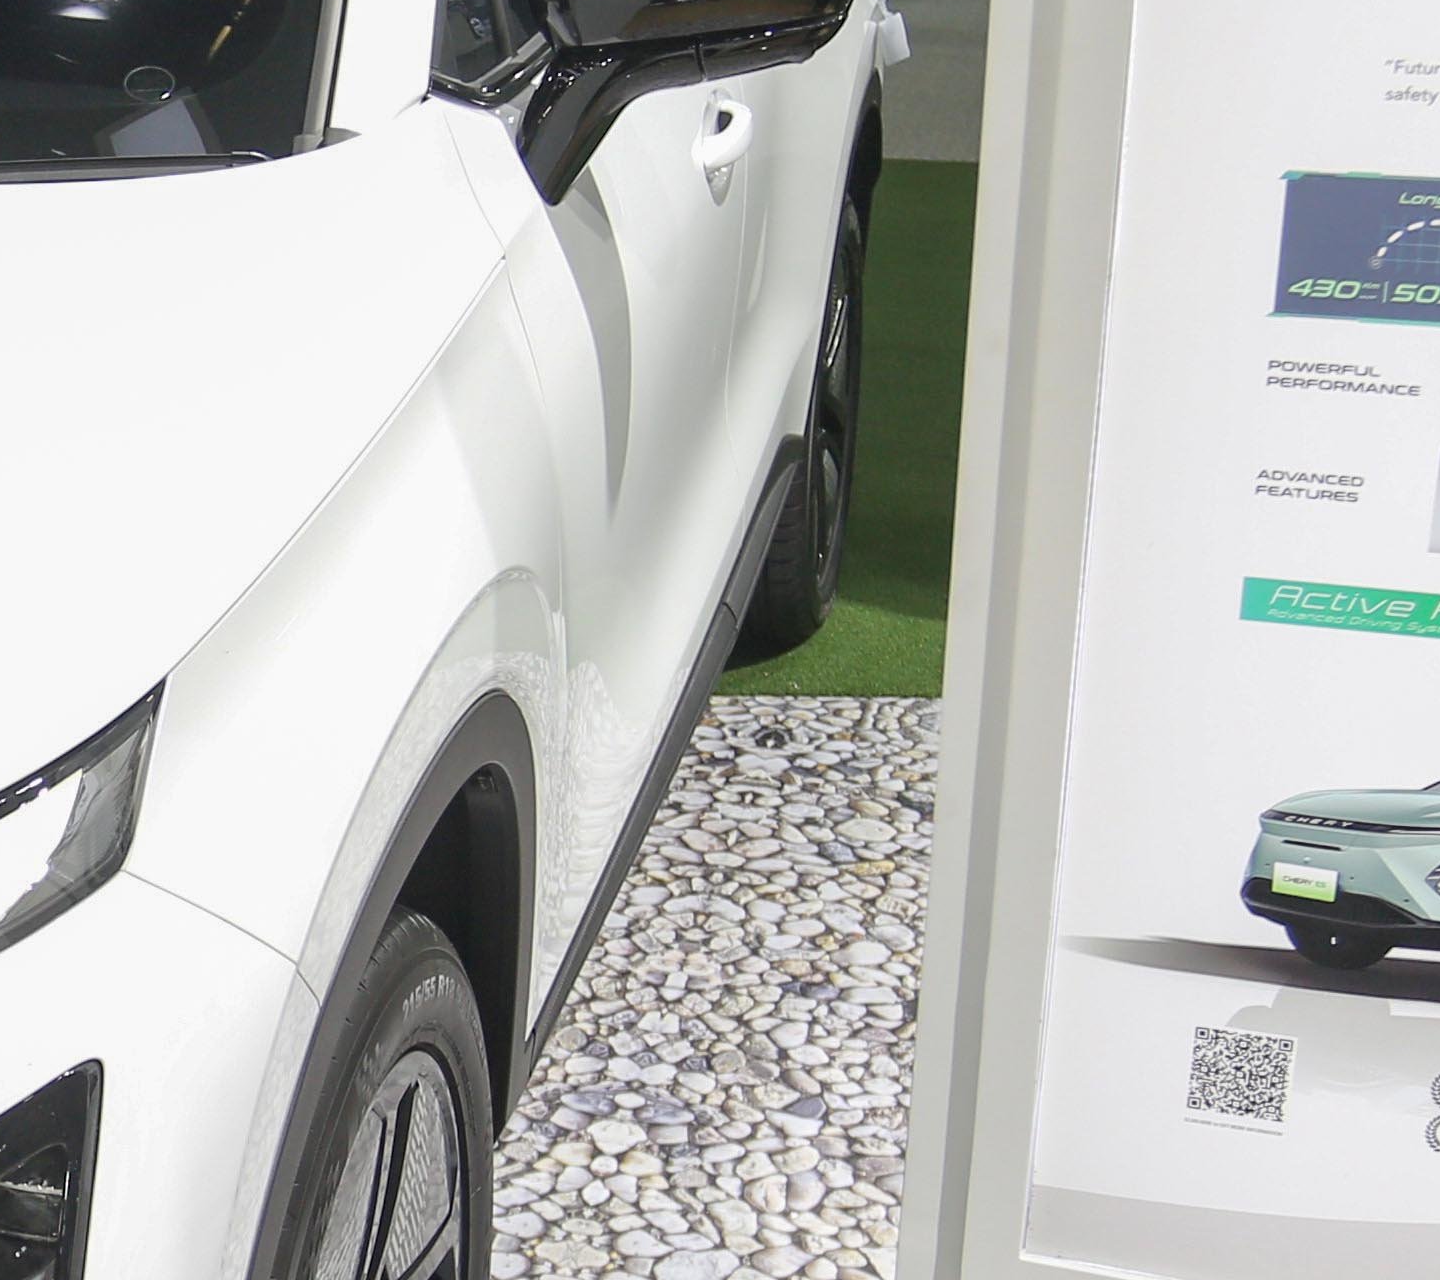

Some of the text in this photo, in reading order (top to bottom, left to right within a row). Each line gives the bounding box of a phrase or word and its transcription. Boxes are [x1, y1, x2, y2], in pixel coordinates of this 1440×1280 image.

[1385, 87, 1439, 105] safety
[1288, 278, 1361, 300] 430
[1267, 359, 1381, 378] POWERFUL
[1266, 376, 1422, 397] PERFORMANCE
[1257, 468, 1365, 488] ADVANCED
[1254, 484, 1360, 503] FEATURES
[1267, 584, 1417, 618] Active
[1349, 615, 1403, 632] Driving
[1284, 815, 1354, 828] CHERY
